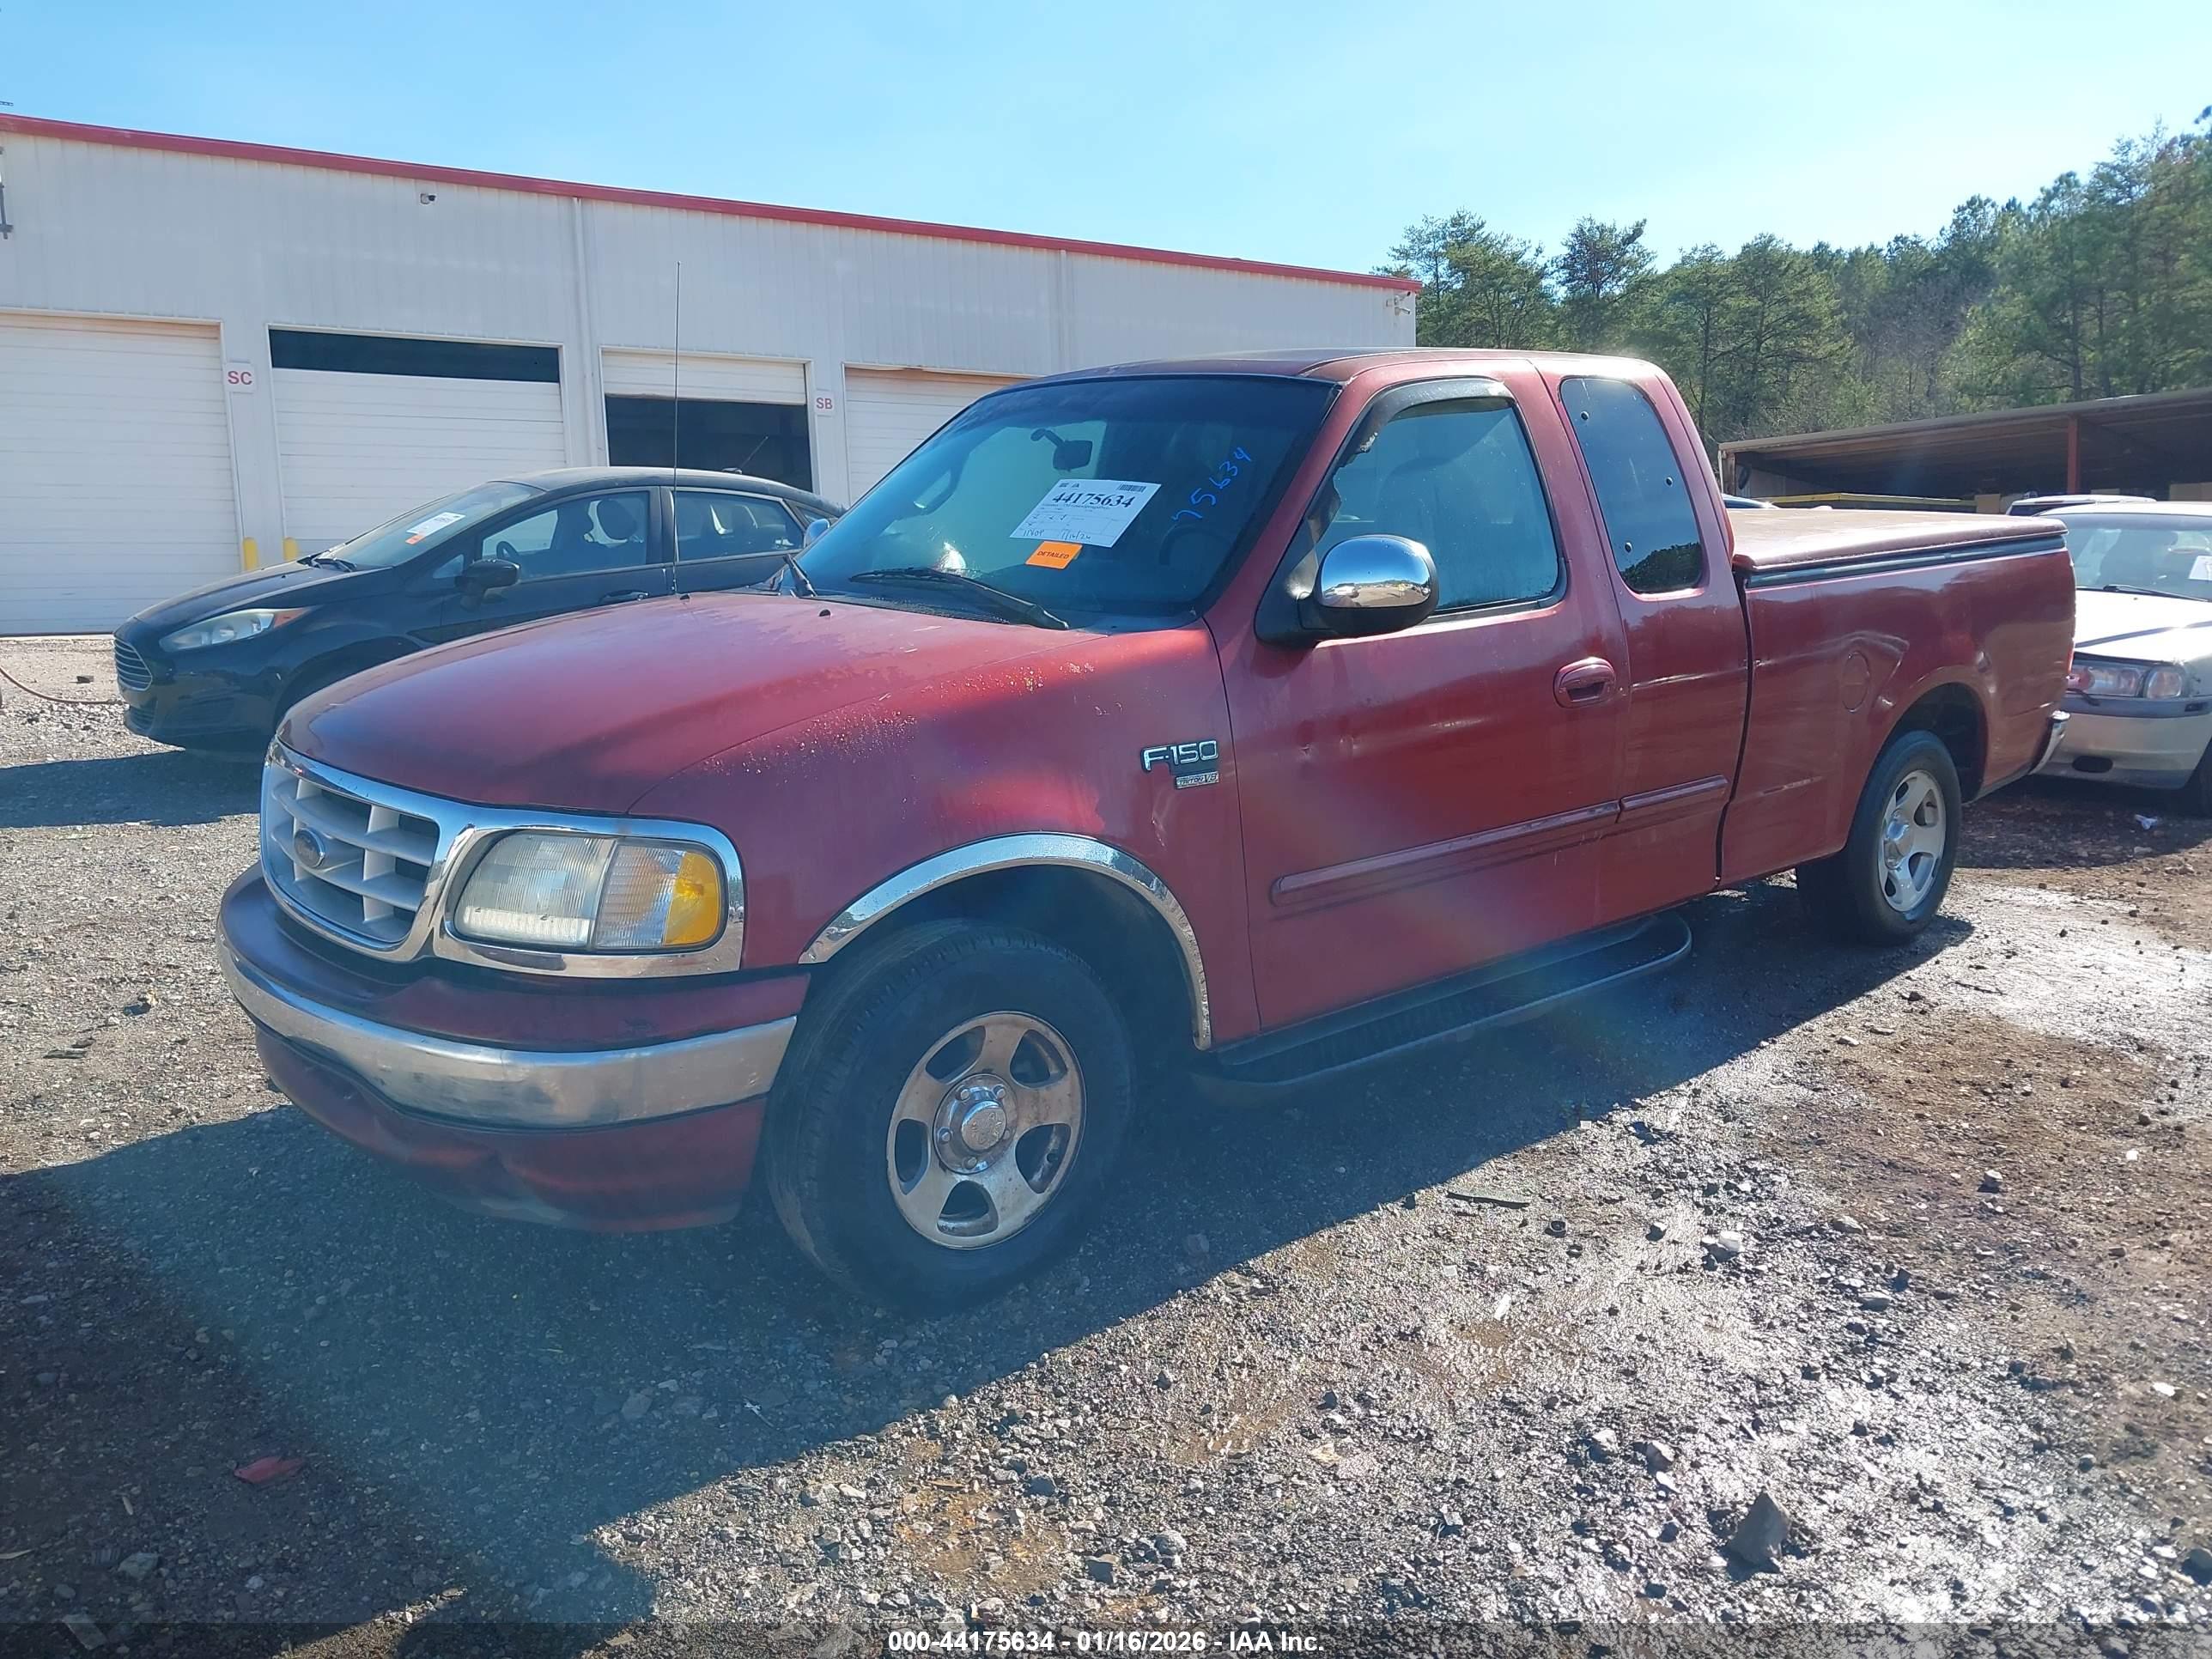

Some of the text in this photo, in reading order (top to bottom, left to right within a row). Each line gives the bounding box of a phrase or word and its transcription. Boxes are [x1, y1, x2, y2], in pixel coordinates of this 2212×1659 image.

[228, 370, 252, 385] SC
[816, 397, 833, 410] SB
[1052, 491, 1135, 508] 44175634
[1036, 550, 1070, 560] DETAILED
